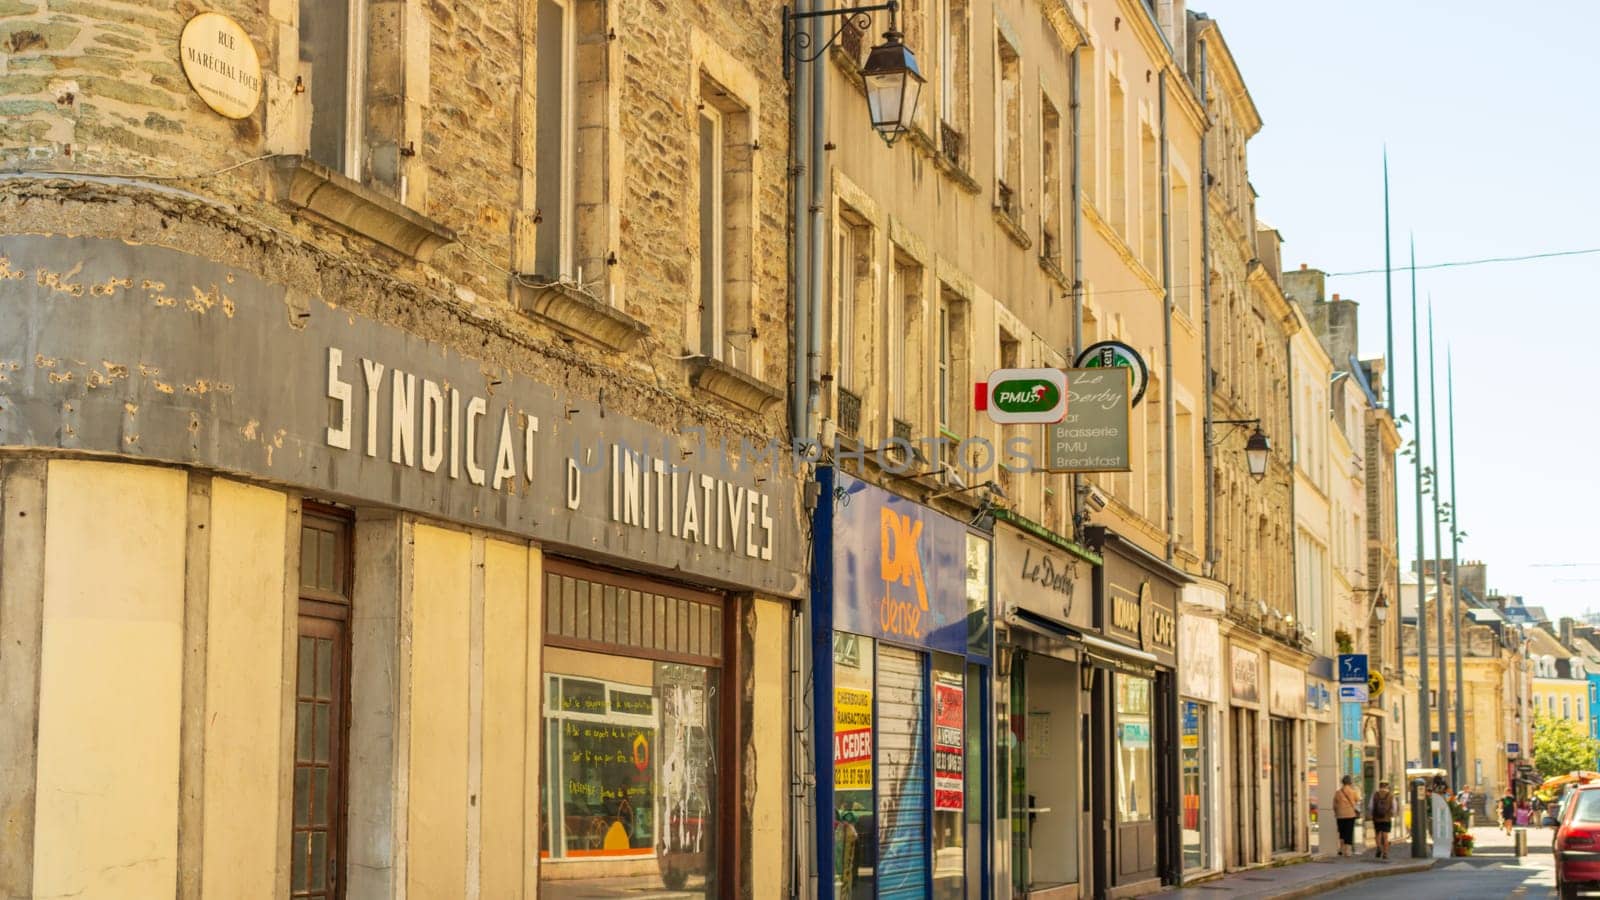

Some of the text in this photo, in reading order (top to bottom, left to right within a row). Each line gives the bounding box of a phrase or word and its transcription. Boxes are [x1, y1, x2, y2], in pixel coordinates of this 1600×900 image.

[217, 31, 235, 50] RUE
[239, 70, 258, 92] FOCH
[1073, 371, 1104, 385] Le
[999, 390, 1030, 403] PMU
[1063, 412, 1080, 423] ar
[1056, 426, 1119, 438] Brasserie
[327, 347, 539, 490] SYNDICAT
[611, 443, 773, 561] INITIATIVES
[1056, 441, 1087, 453] PMU
[1056, 455, 1121, 468] Breakfast
[880, 506, 929, 612] DK
[1022, 549, 1079, 618] Le Derby
[880, 580, 922, 640] dense
[837, 691, 868, 707] CHERBOURG
[843, 731, 871, 760] CEDER
